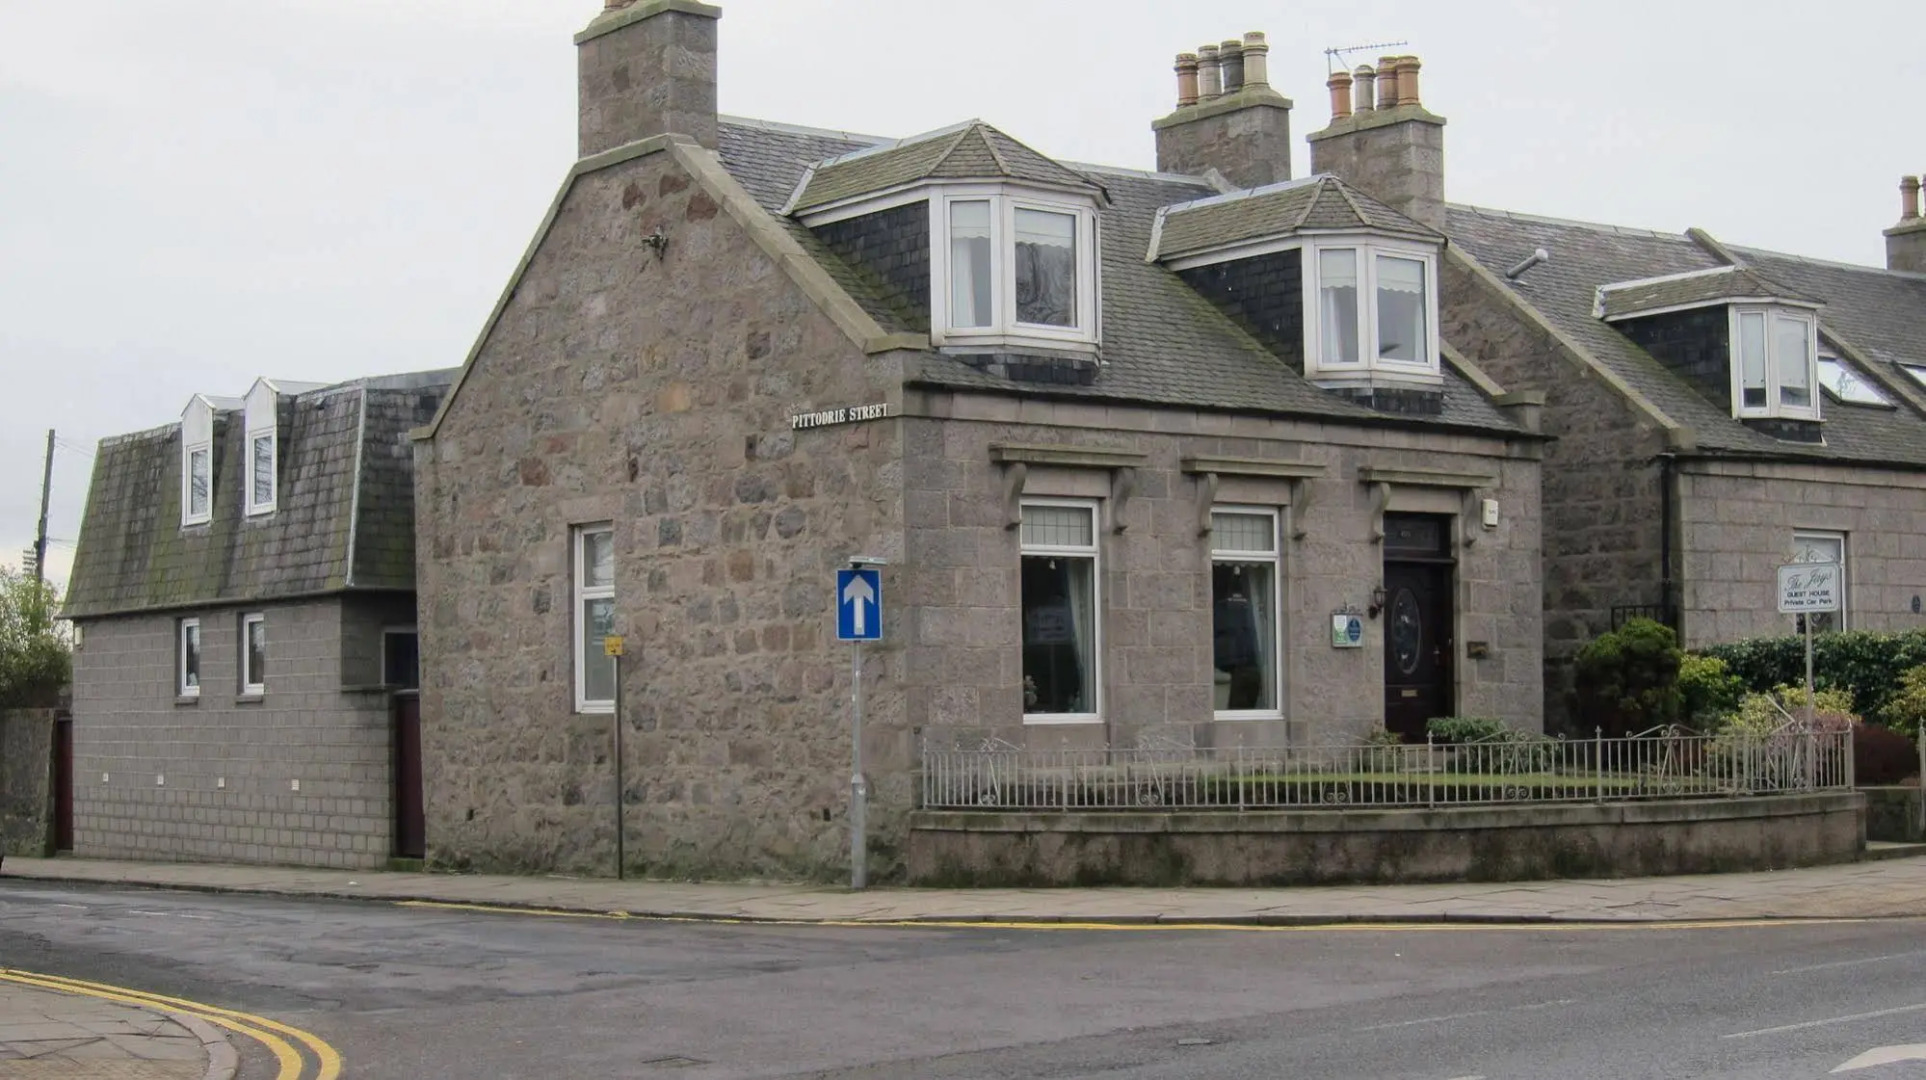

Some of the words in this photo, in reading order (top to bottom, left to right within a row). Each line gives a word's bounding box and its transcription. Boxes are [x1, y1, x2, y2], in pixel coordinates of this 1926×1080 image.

[792, 408, 846, 429] PITTODRIE
[849, 403, 888, 421] STREET
[1809, 589, 1830, 597] HOUSE
